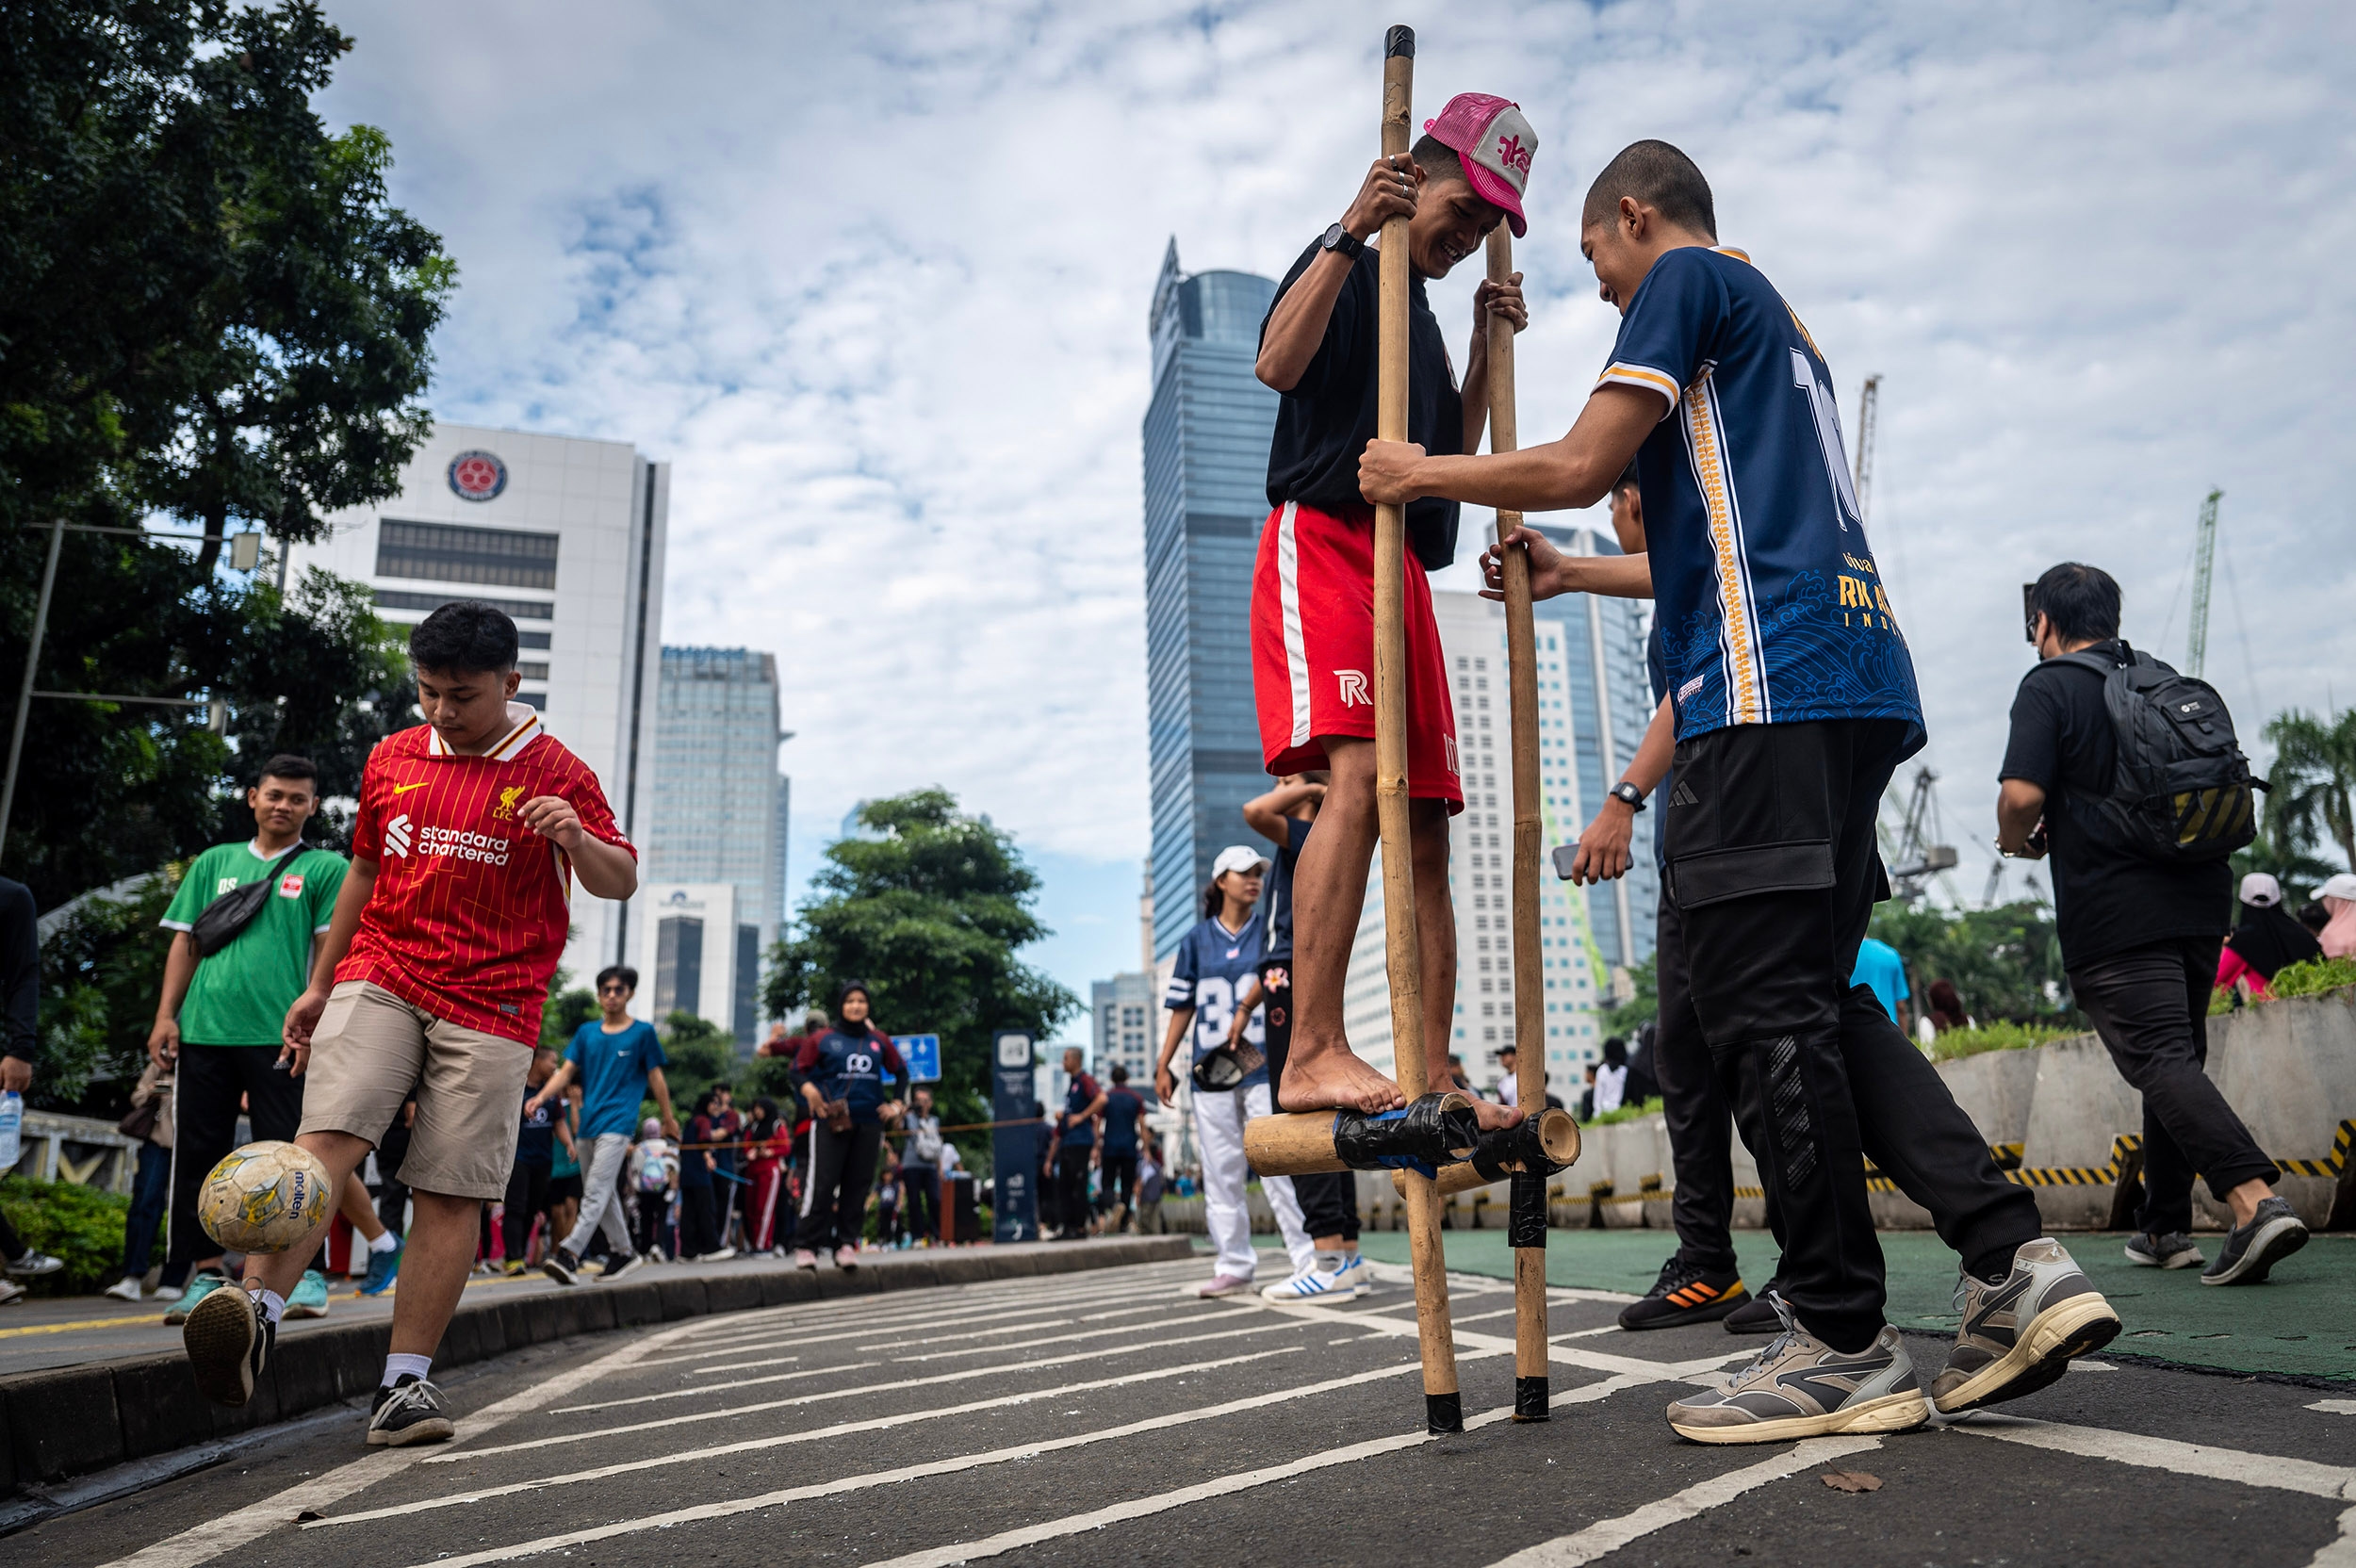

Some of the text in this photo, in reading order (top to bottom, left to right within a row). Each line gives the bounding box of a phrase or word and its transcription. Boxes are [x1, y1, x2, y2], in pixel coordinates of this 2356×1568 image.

[1838, 575, 1873, 610] RK
[417, 841, 509, 866] chartered
[420, 825, 509, 852] standard
[288, 1171, 305, 1220] molten
